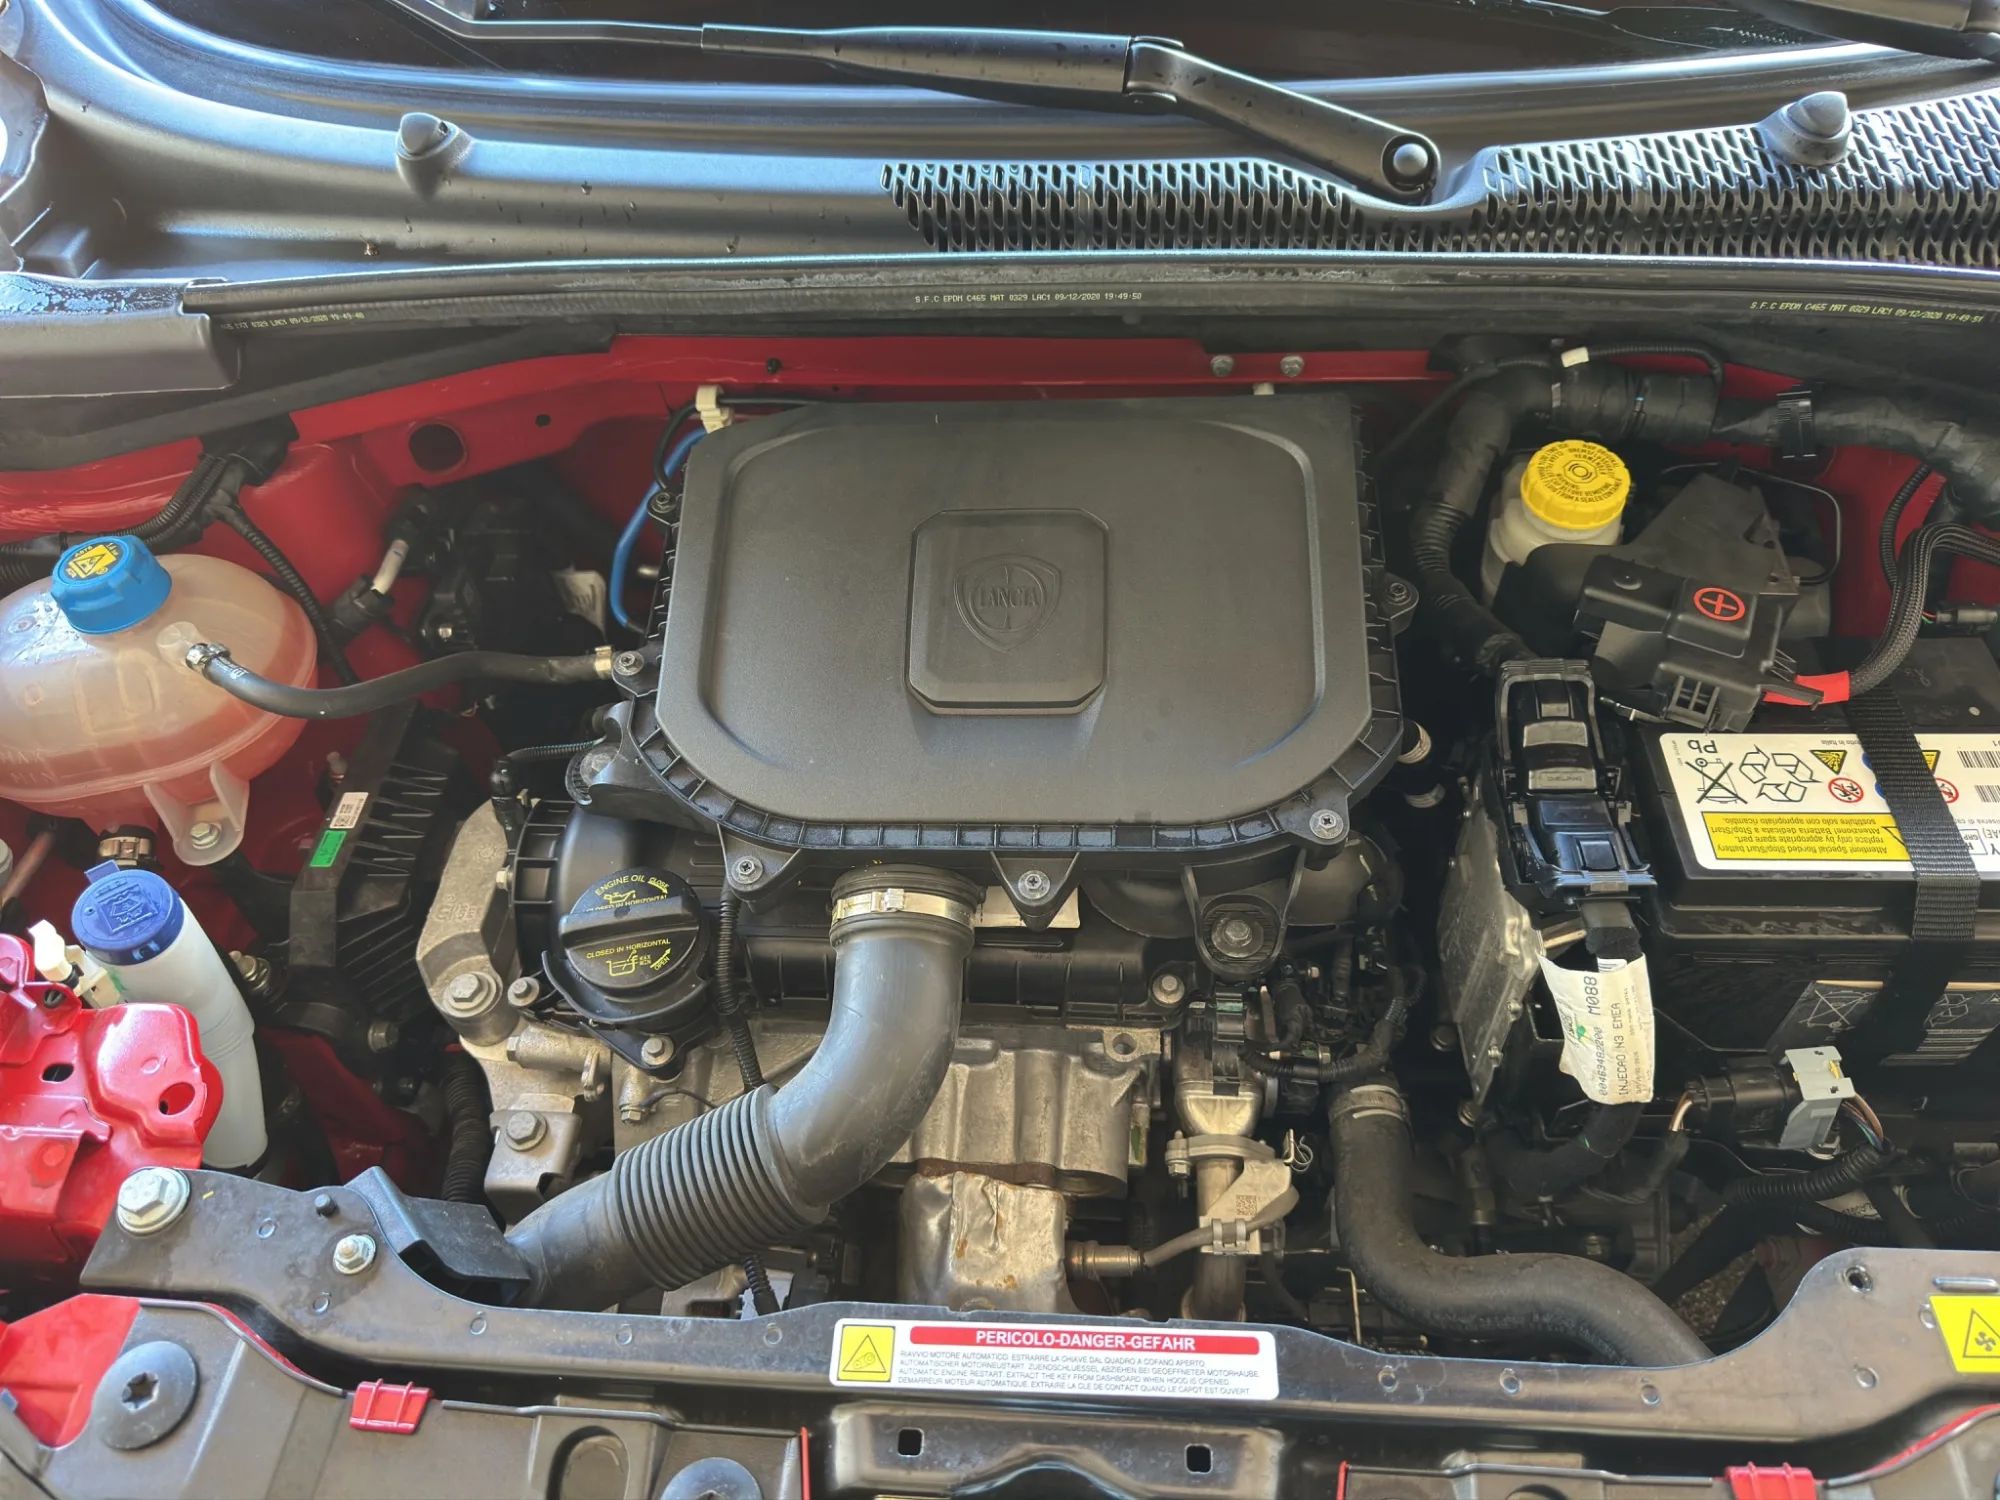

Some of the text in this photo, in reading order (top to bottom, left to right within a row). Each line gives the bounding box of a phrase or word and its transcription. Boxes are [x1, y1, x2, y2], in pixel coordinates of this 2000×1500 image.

[943, 294, 963, 302] EPDM
[1829, 304, 1848, 312] MAT
[976, 586, 1040, 608] LANCIA
[1687, 740, 1718, 754] Pb
[595, 874, 646, 896] ENGINE OIL
[649, 876, 670, 889] CLOSE
[586, 948, 615, 959] CLOSED
[626, 938, 671, 951] HORIZONTAL
[654, 956, 670, 970] OPEN
[1610, 1002, 1623, 1029] EMEA
[976, 1330, 1196, 1351] PERICOLO-DANGER-GEFAHR
[900, 1359, 959, 1368] AUTOMATISCHER
[930, 1351, 960, 1359] MOTORE
[1104, 1357, 1135, 1365] QUADRO
[1144, 1358, 1174, 1366] COFANO
[899, 1368, 940, 1376] AUTOMATIC
[1007, 1371, 1039, 1379] EXTRACT
[1041, 1372, 1055, 1380] THE
